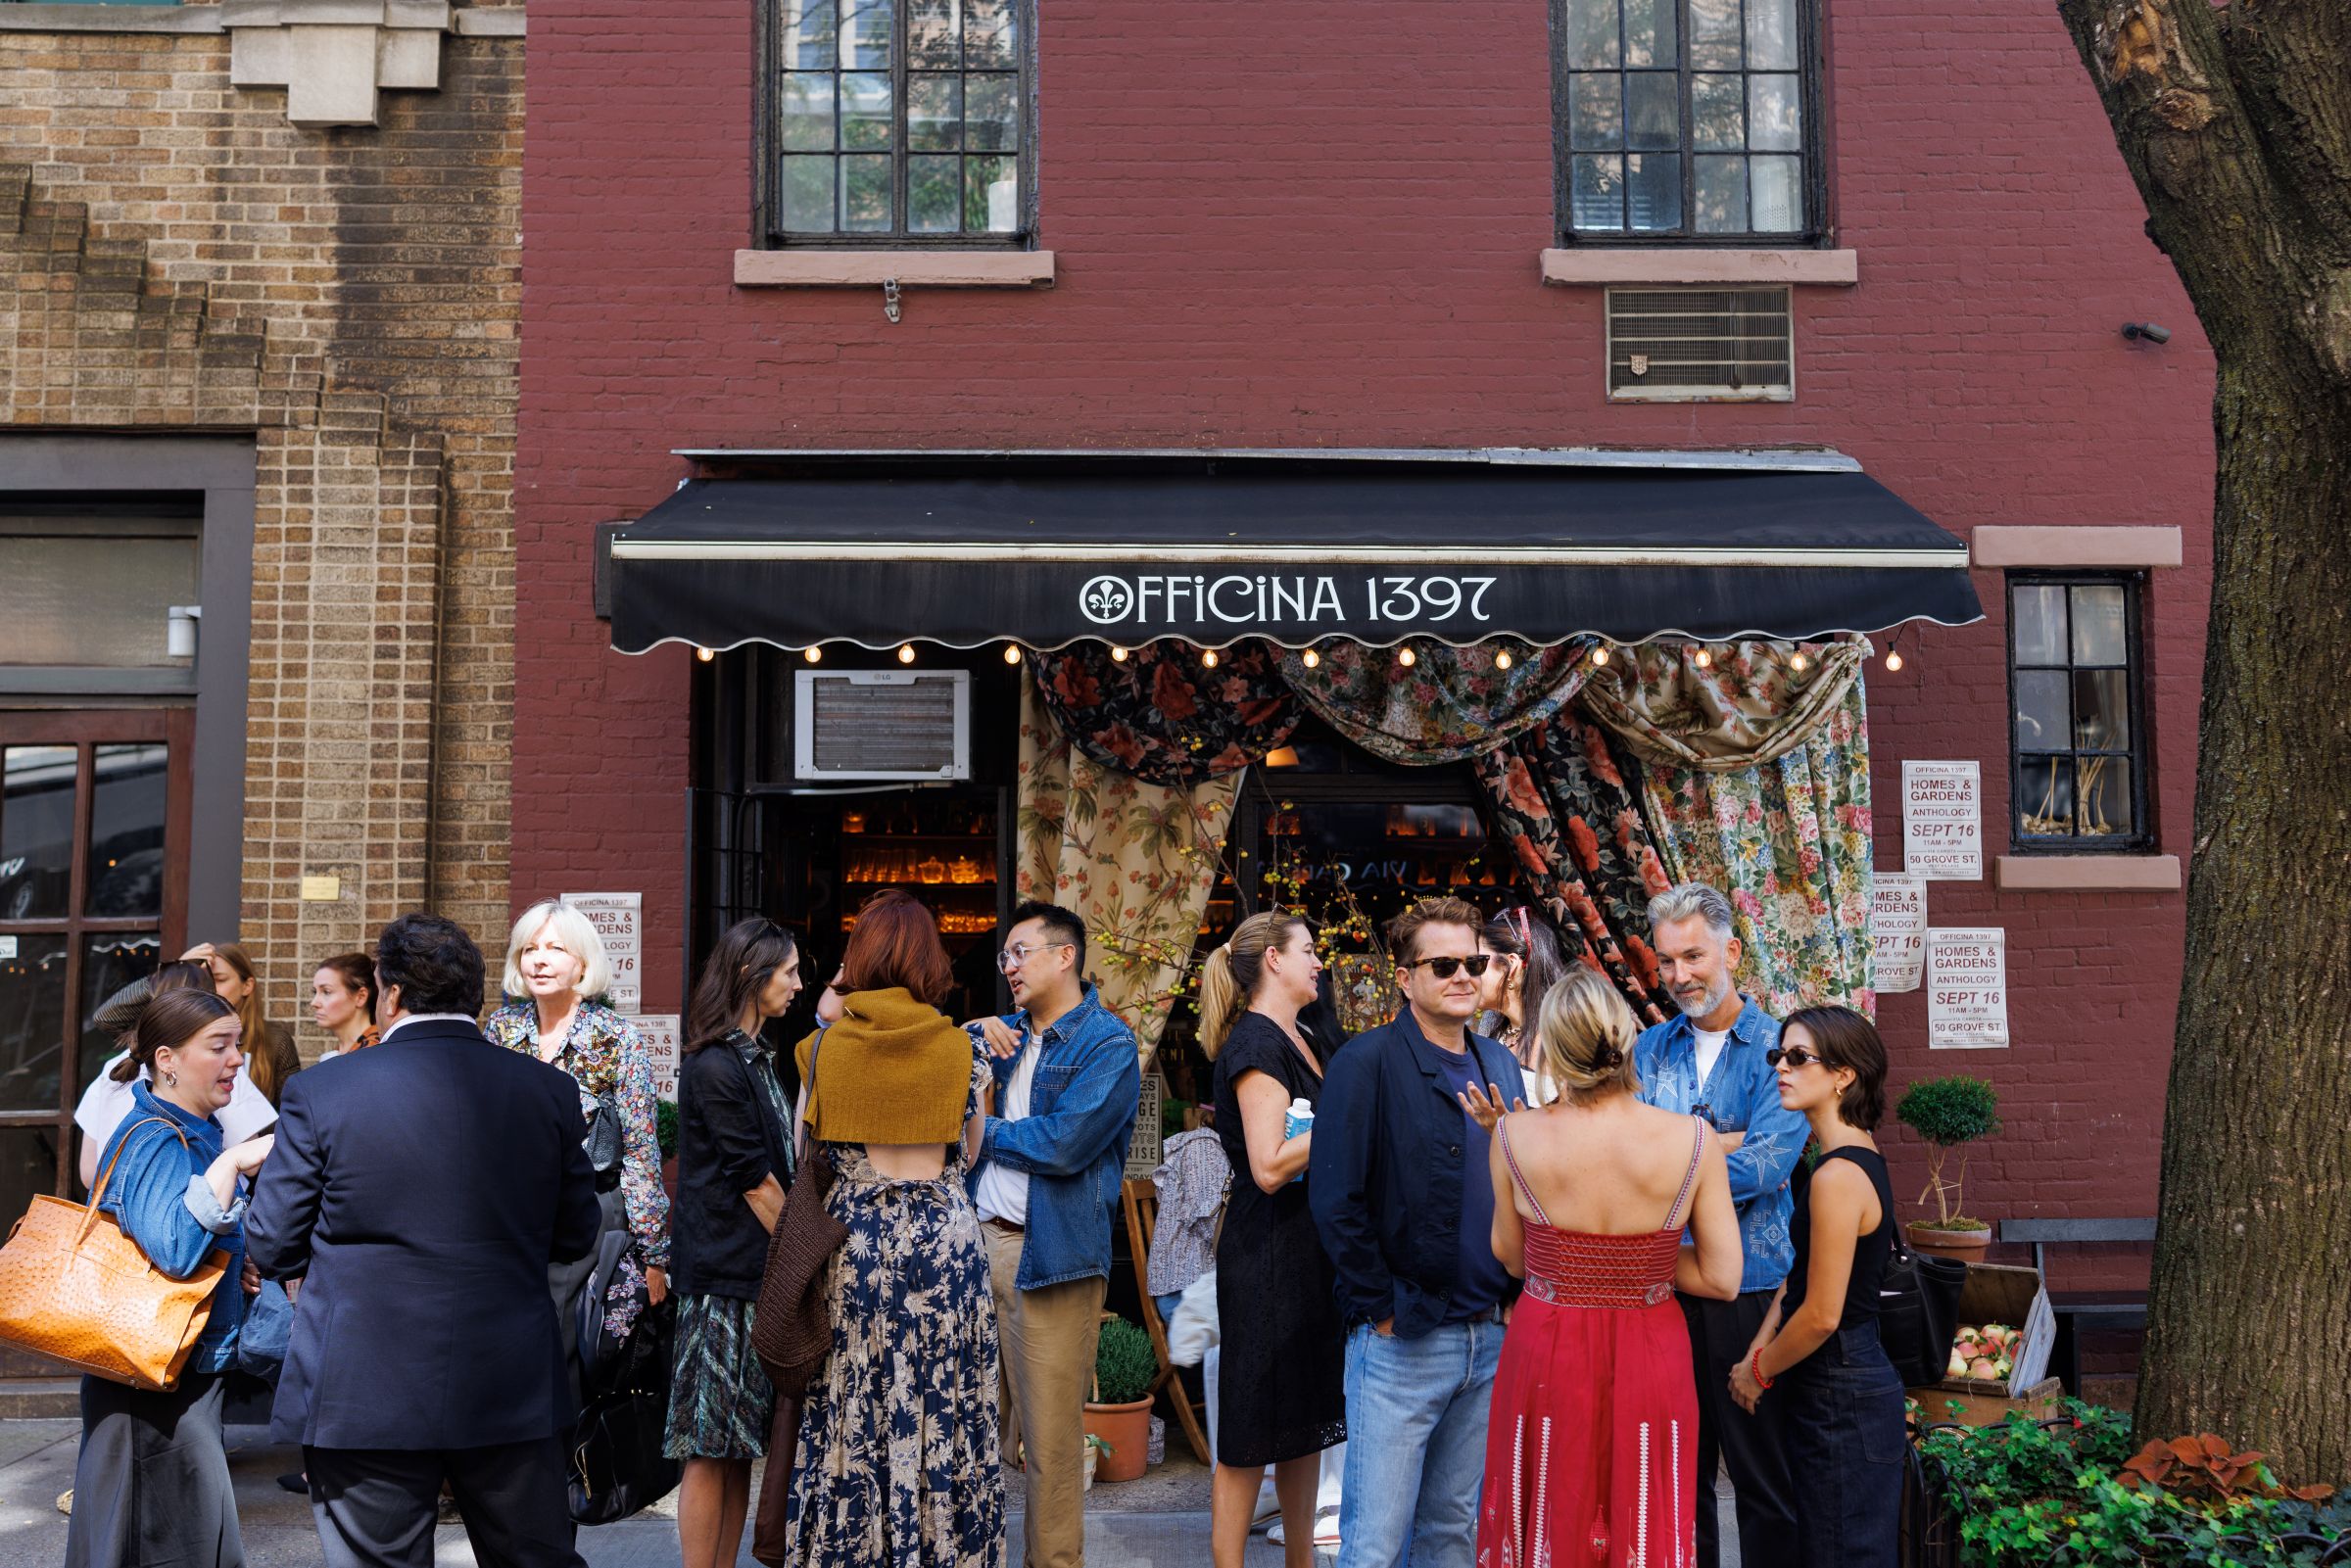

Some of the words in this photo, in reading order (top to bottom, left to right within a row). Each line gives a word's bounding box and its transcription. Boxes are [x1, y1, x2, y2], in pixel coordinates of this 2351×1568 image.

[1366, 576, 1498, 622] 1397
[1910, 780, 1956, 789] HOMES
[1963, 779, 1972, 789] &
[1910, 791, 1973, 801] GARDENS
[1911, 824, 1954, 837] SEPT
[1957, 824, 1975, 836] 16
[1910, 855, 1921, 864] 50
[1962, 855, 1977, 864] ST.
[1909, 891, 1918, 901] &
[623, 912, 633, 923] &
[594, 924, 633, 934] DENS
[1903, 935, 1921, 949] 16
[1935, 946, 1981, 956] HOMES
[1987, 946, 1996, 956] &
[617, 957, 635, 971] 16
[1935, 959, 1997, 969] GARDENS
[1876, 967, 1905, 976] ROVE
[1936, 991, 1980, 1005] SEPT
[1983, 991, 2000, 1004] 16
[662, 1034, 672, 1044] &
[657, 1080, 674, 1093] 16
